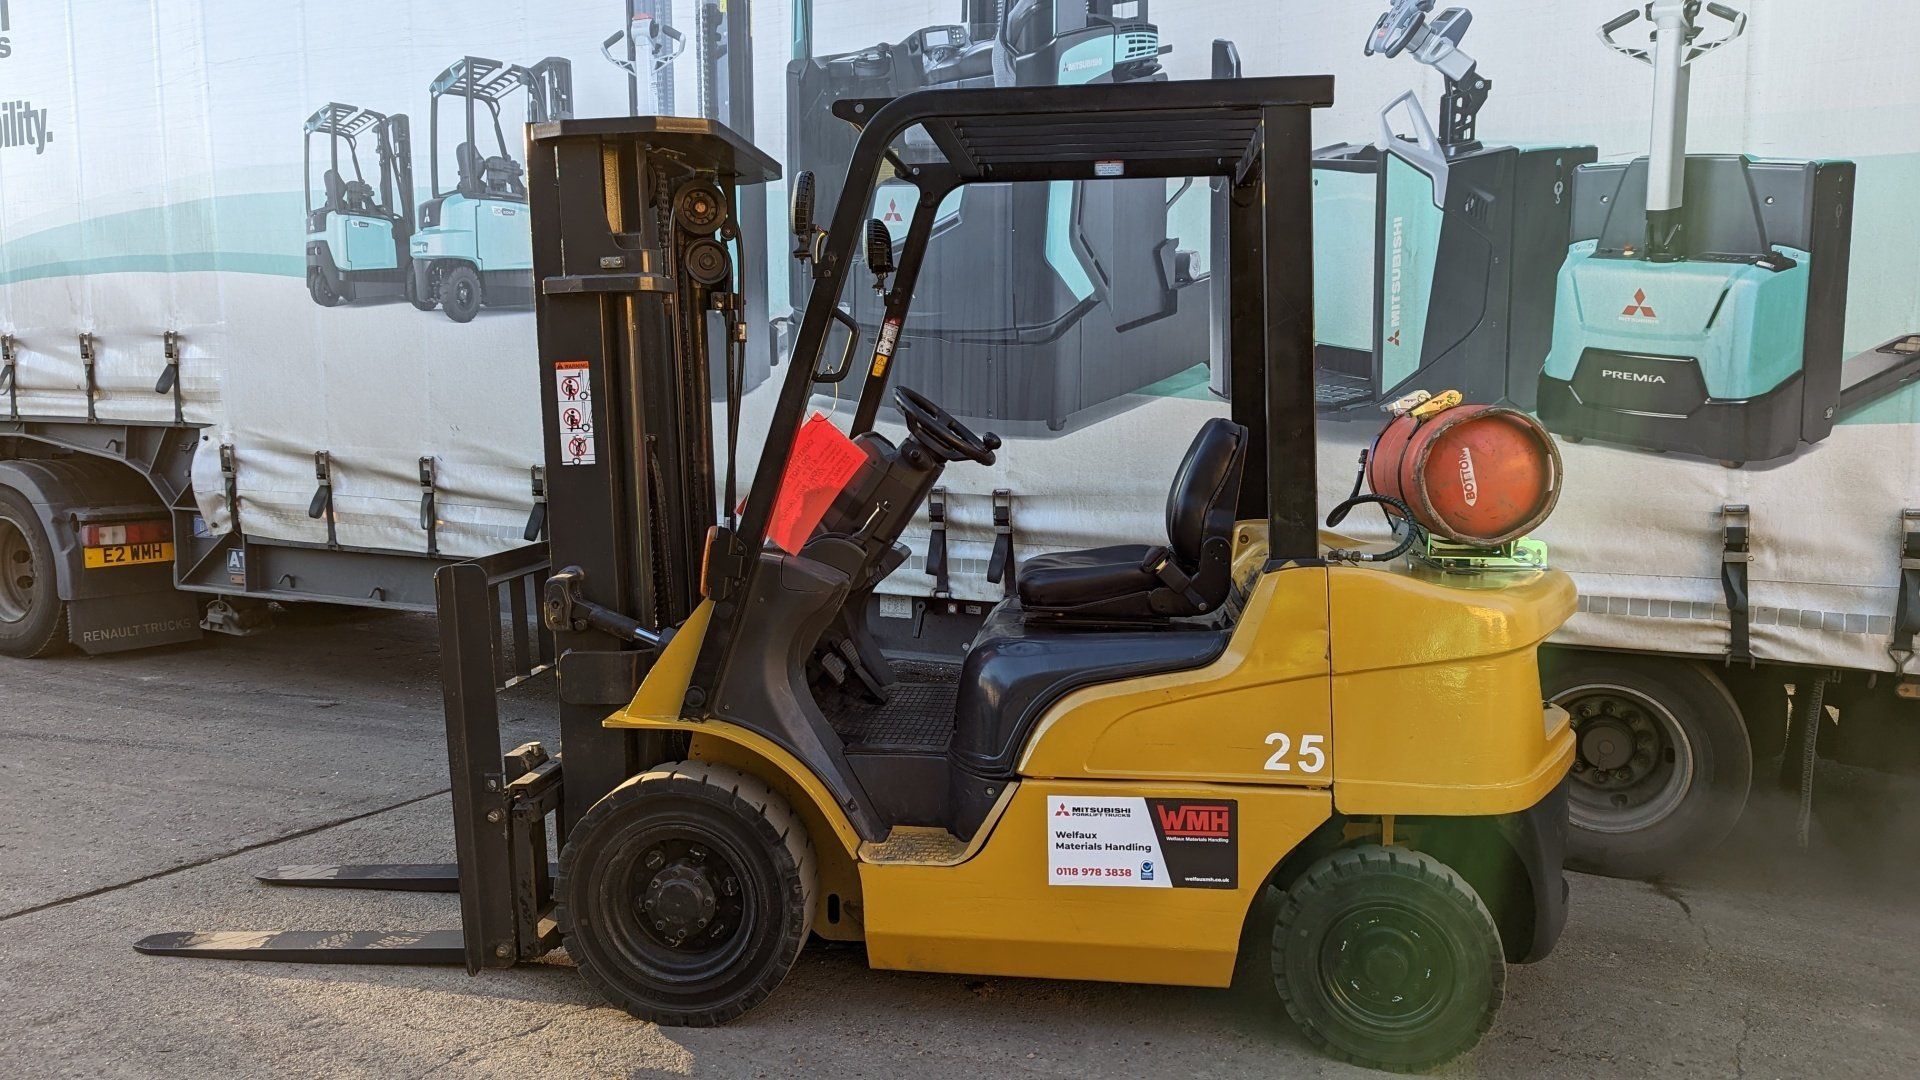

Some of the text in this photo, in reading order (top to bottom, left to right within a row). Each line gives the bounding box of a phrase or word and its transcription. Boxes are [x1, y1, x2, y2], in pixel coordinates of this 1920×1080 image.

[0, 100, 53, 154] ility.
[1391, 216, 1402, 327] MITSUBISHI
[103, 544, 162, 563] E2 WMH
[83, 618, 191, 643] RENAULT TRUCKS
[1263, 732, 1325, 773] 25
[1157, 804, 1229, 831] WMH
[1055, 831, 1097, 839] Welfaux
[1055, 842, 1152, 853] Materials Handling
[1056, 867, 1078, 876] 0118
[1081, 868, 1101, 876] 978
[1105, 868, 1132, 877] 3838
